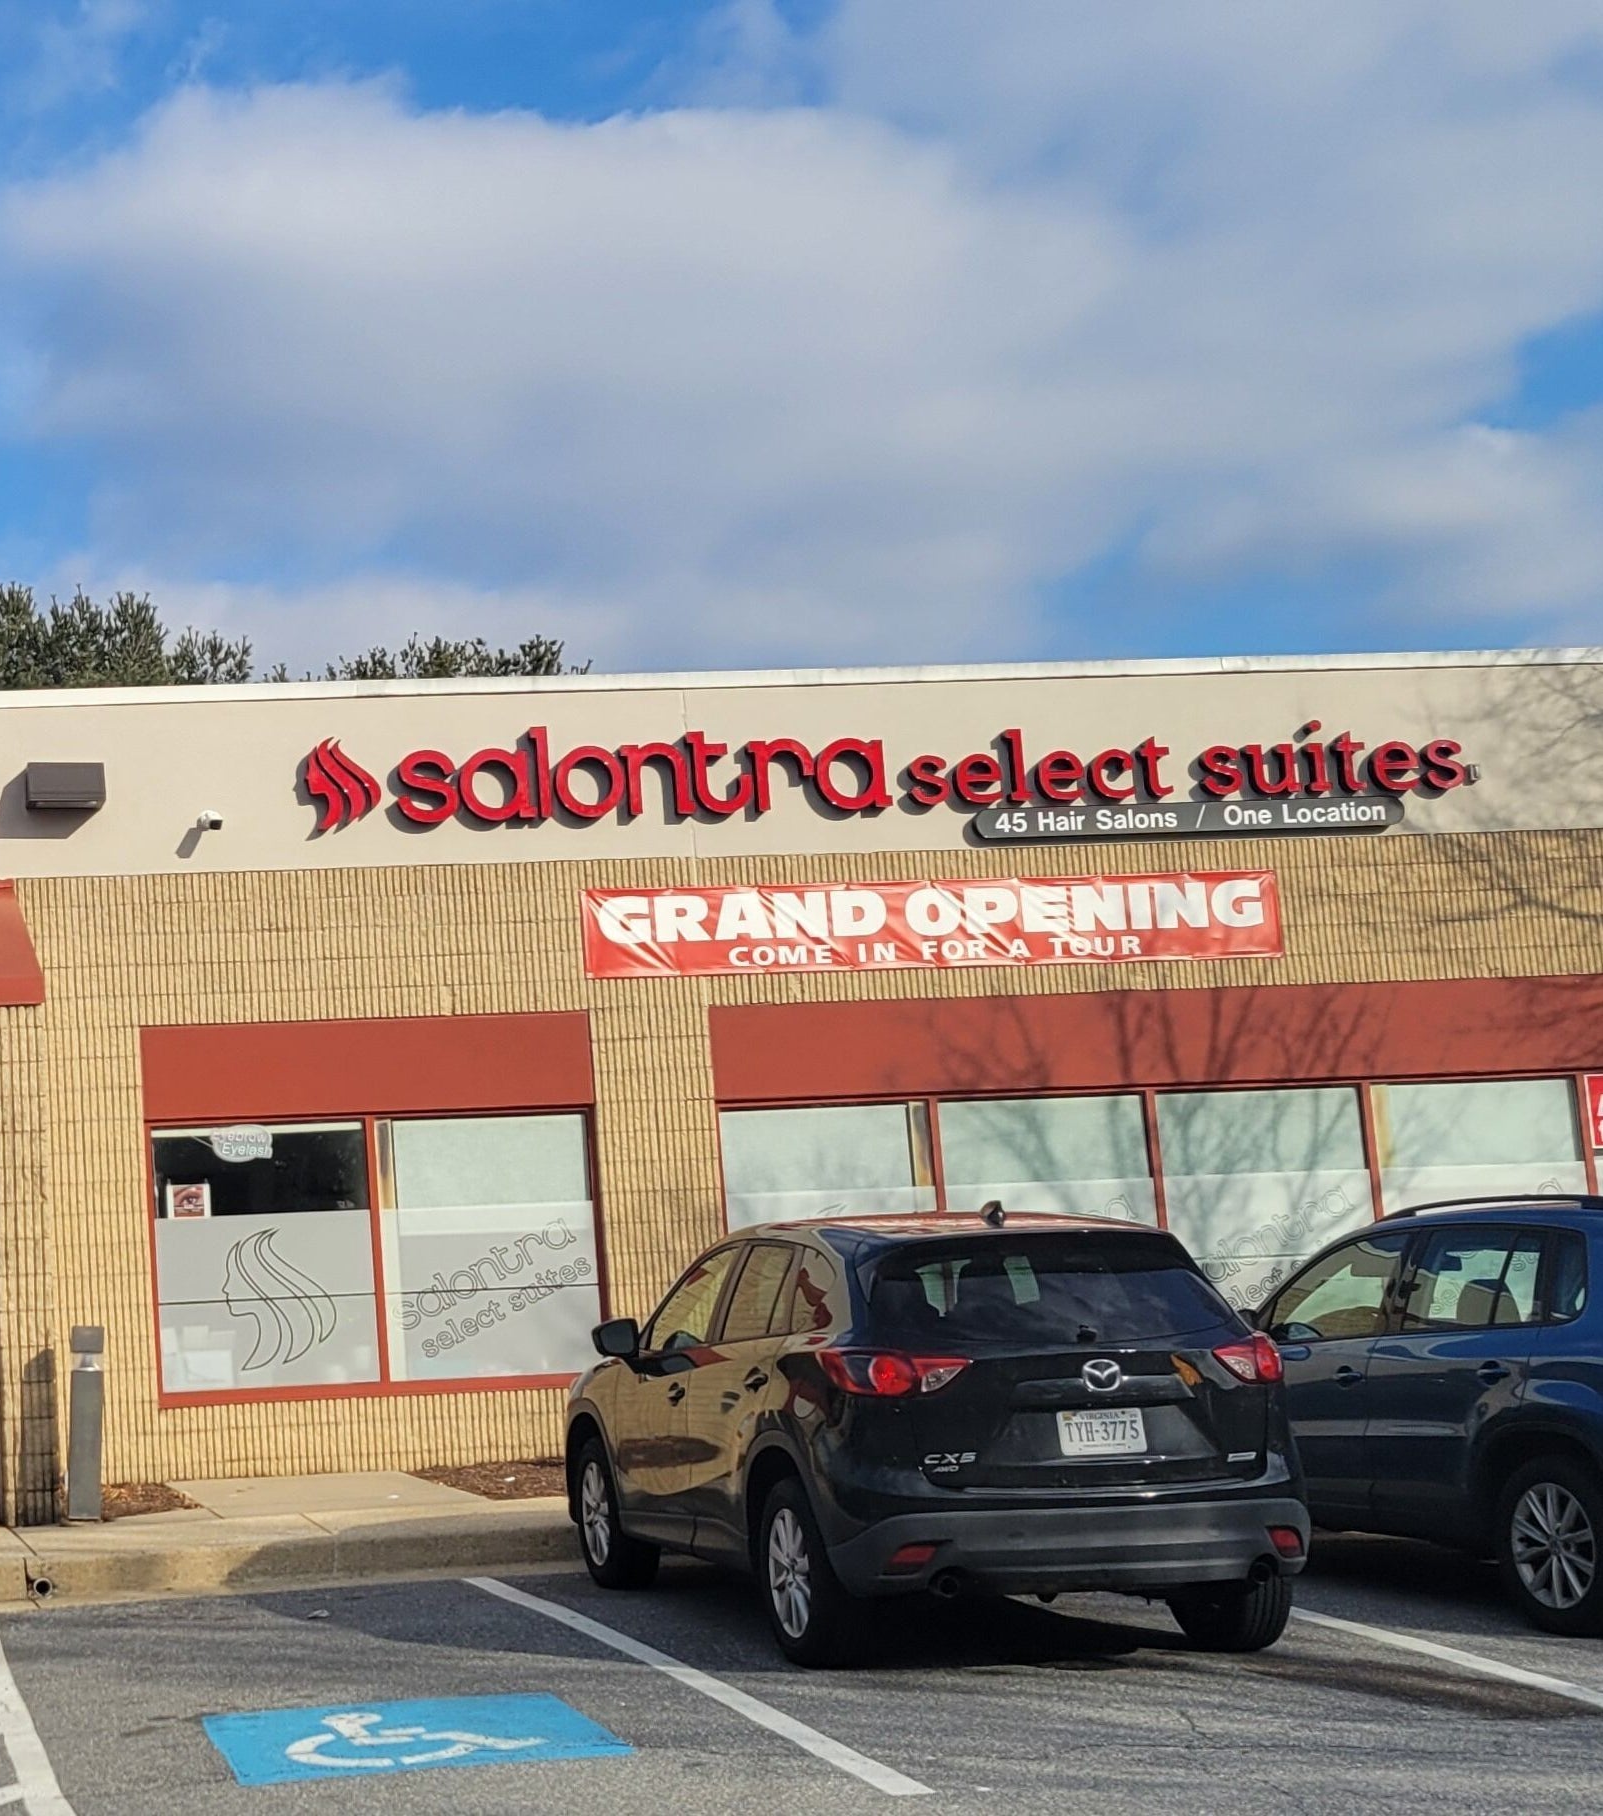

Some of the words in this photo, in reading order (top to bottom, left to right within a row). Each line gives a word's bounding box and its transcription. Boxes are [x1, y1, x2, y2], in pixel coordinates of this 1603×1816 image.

[395, 726, 893, 824] salontra
[906, 729, 1175, 806] select
[1200, 719, 1467, 798] suites
[995, 812, 1027, 833] 45
[1037, 809, 1085, 832] Hair
[1095, 807, 1178, 831] Salons
[1195, 804, 1208, 829] /
[1224, 804, 1272, 826] One
[1282, 801, 1387, 823] Location
[597, 889, 887, 945] GRAND
[904, 879, 1266, 935] OPENING
[728, 944, 833, 967] COME
[859, 942, 897, 963] IN
[921, 939, 987, 961] FOR
[1007, 938, 1031, 959] A
[1049, 935, 1143, 957] TOUR
[392, 1218, 577, 1330] salontra
[1202, 1185, 1354, 1283] alontra
[421, 1300, 506, 1358] select
[508, 1256, 592, 1312] suites
[1064, 1420, 1140, 1442] TYH-3775
